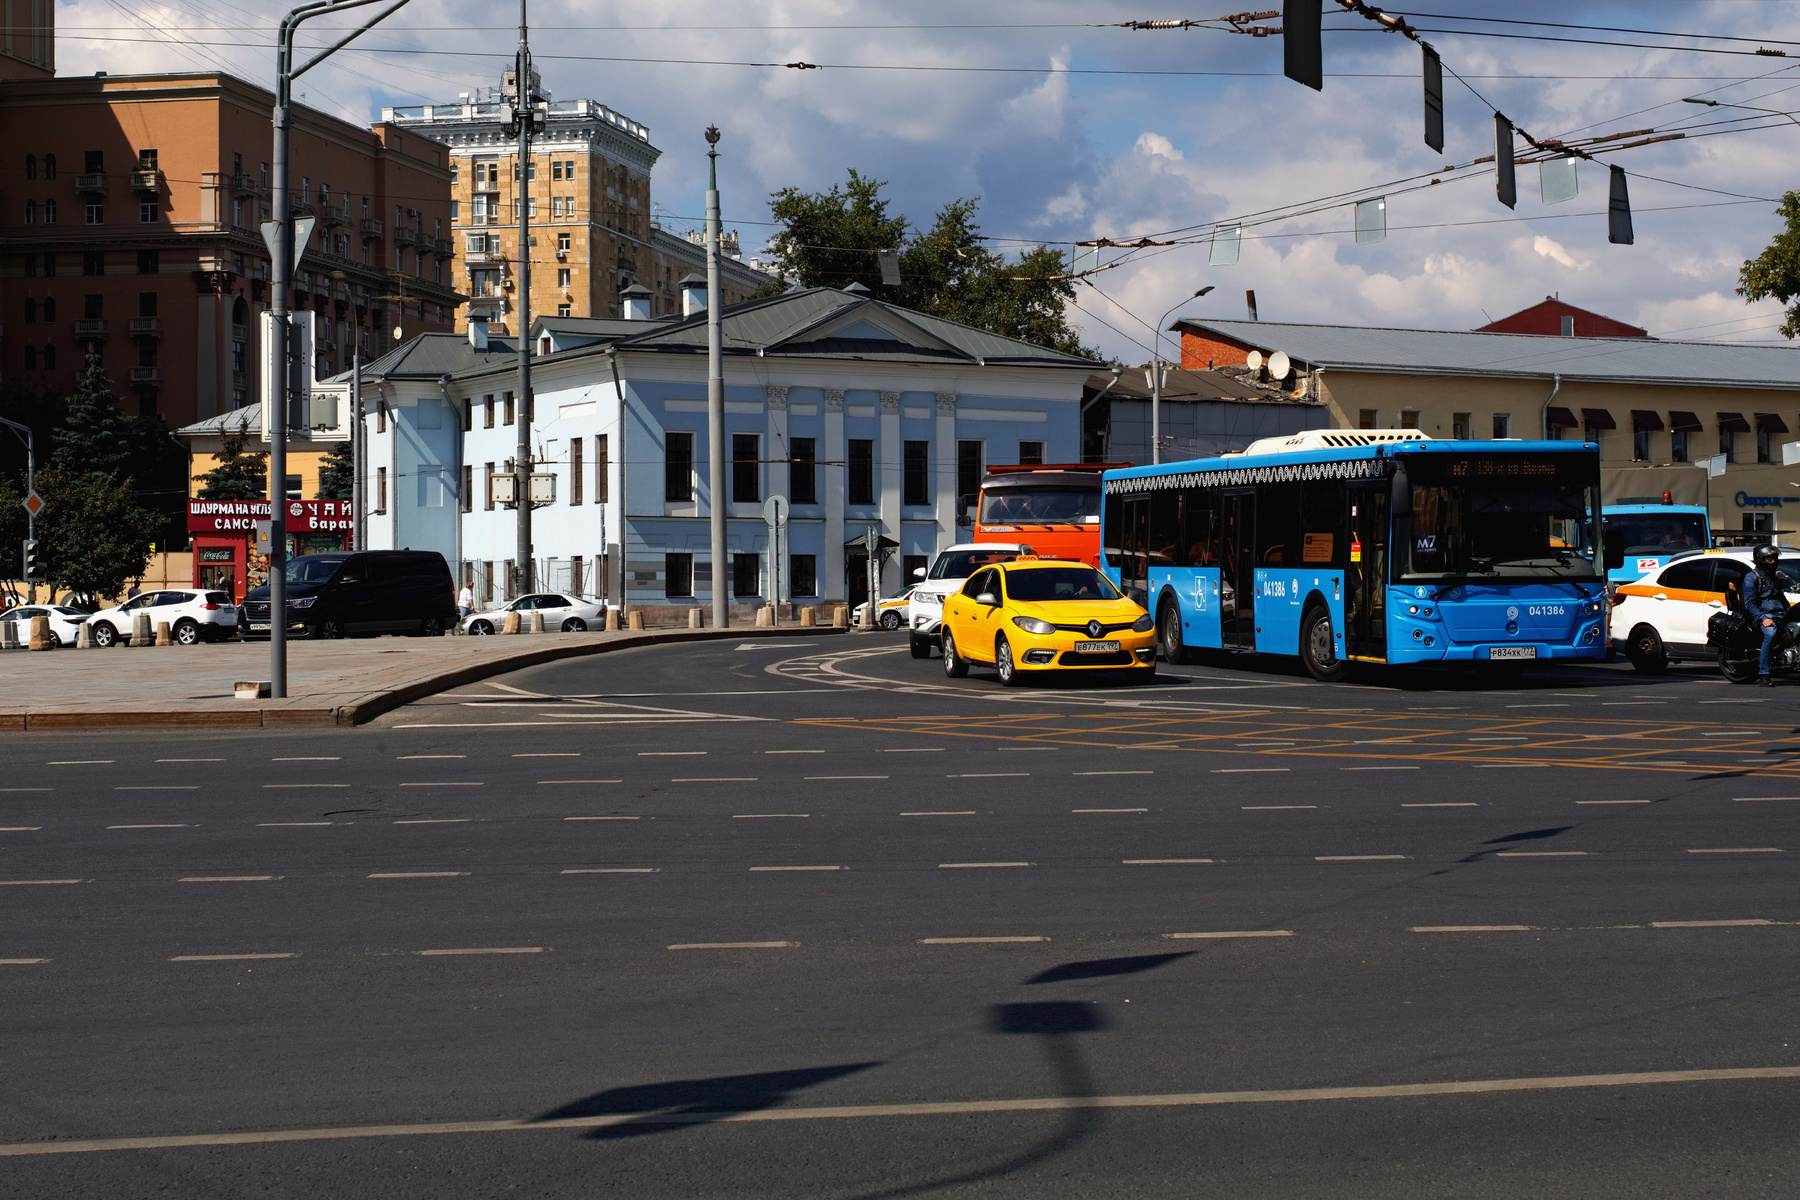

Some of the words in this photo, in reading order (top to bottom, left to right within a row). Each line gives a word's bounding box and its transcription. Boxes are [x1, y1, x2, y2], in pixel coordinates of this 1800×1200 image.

[190, 503, 235, 515] ШАУРМА
[235, 503, 249, 515] НА
[214, 518, 258, 530] САМСА
[1264, 581, 1286, 597] 041386
[1529, 605, 1565, 616] 041386
